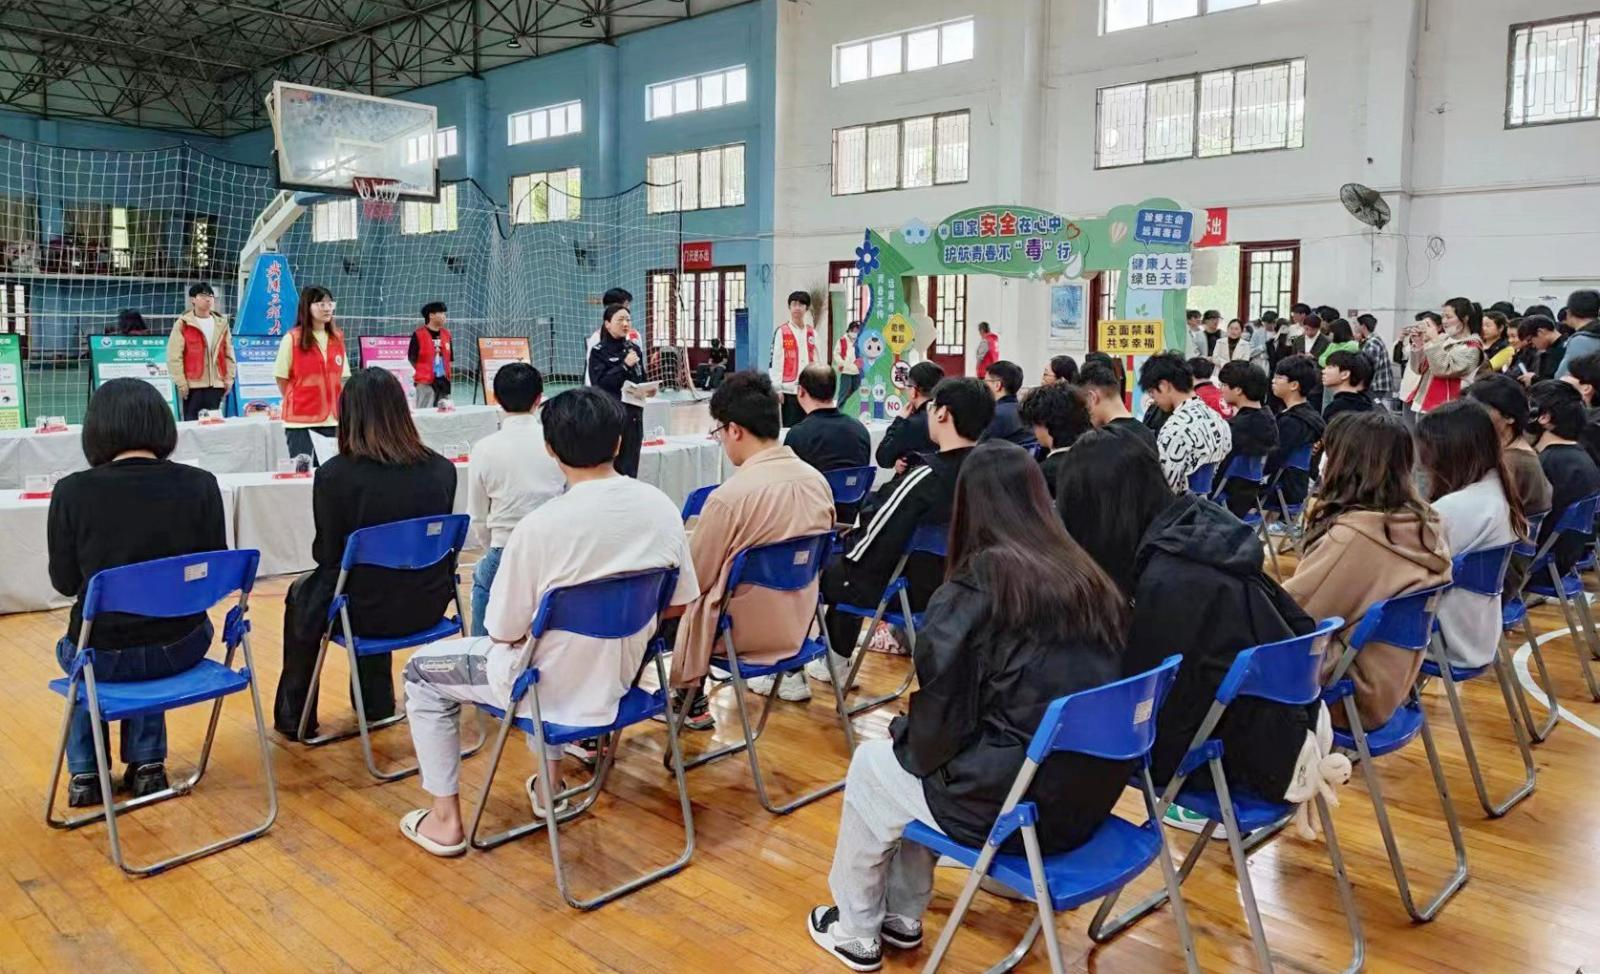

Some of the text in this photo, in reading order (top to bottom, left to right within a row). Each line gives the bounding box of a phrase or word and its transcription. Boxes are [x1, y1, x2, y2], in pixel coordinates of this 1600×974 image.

[952, 212, 1062, 238] 国家安全在心中
[1131, 258, 1188, 270] 健康人生
[1131, 272, 1187, 285] 绿色无毒
[1107, 324, 1155, 336] 全面禁毒
[1106, 338, 1155, 349] 共享幸福
[887, 401, 901, 411] NO
